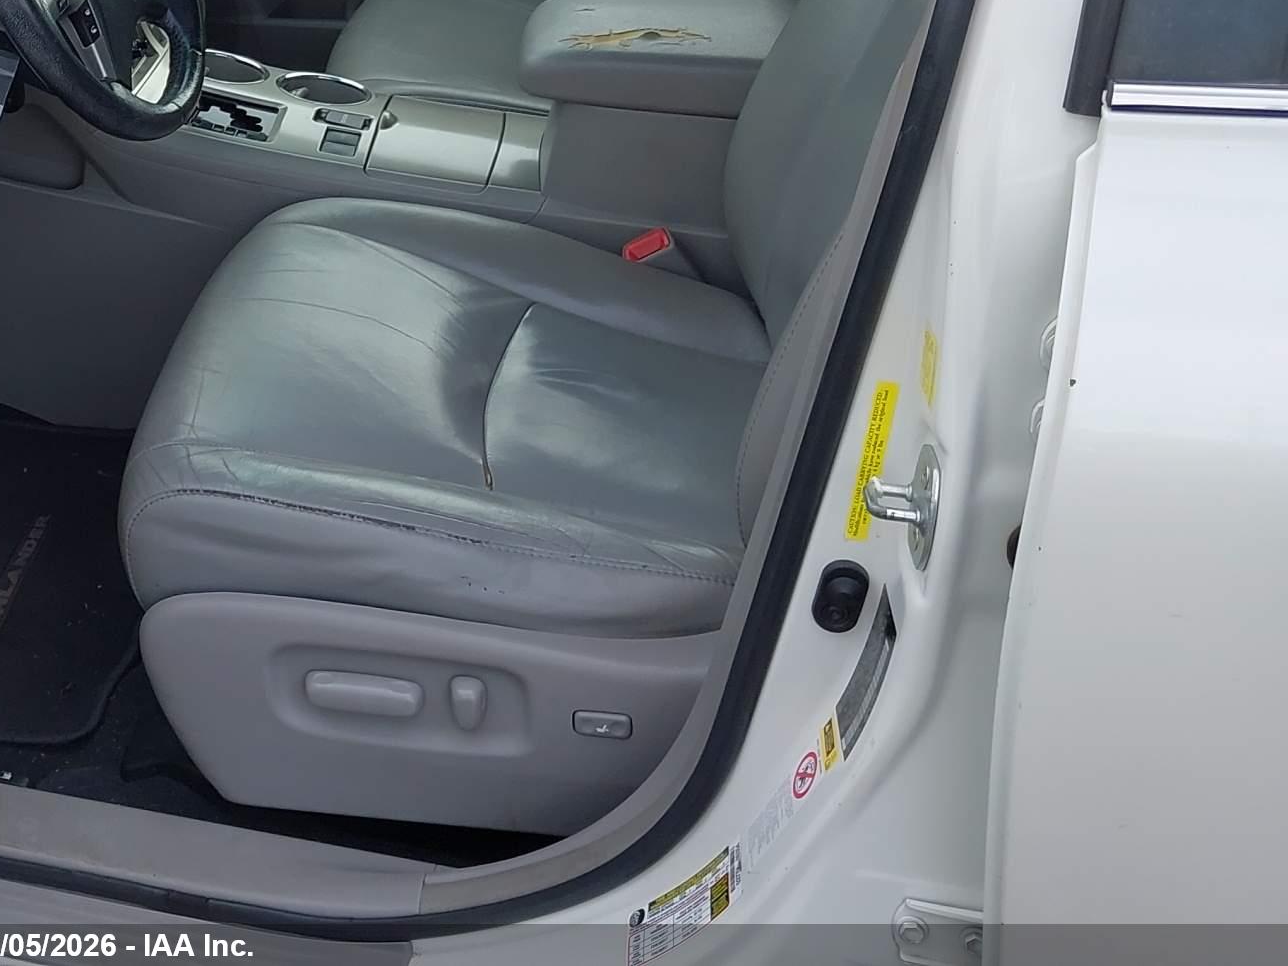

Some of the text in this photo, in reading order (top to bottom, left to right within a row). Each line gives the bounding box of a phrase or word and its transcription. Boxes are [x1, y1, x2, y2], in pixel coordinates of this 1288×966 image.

[871, 391, 882, 422] REDUCED
[864, 423, 875, 453] CAPACITY
[857, 454, 870, 486] CARRYING
[854, 487, 862, 503] LOAD
